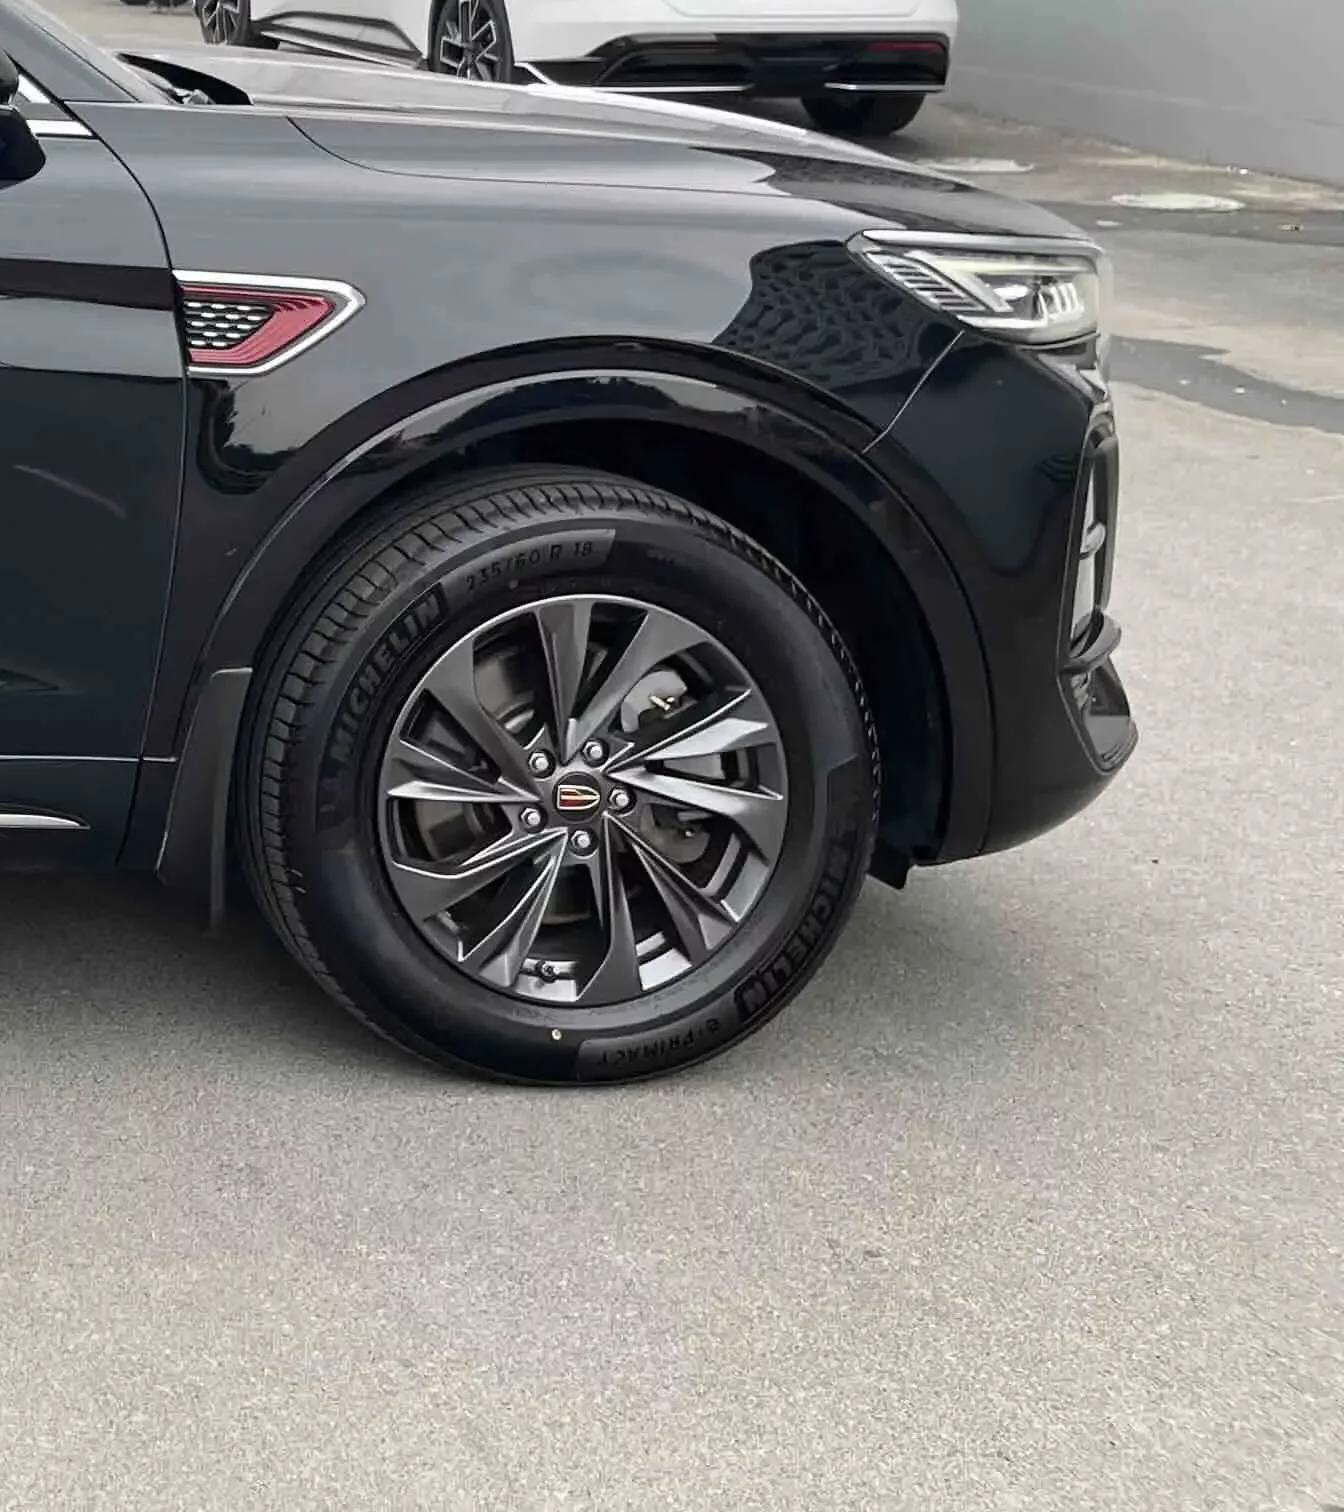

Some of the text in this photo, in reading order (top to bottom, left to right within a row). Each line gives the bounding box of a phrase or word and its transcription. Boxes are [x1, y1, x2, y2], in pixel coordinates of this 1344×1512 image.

[466, 548, 541, 591] 235/60
[548, 544, 563, 562] R
[572, 541, 594, 558] 18
[329, 593, 442, 764] MICHELIN
[740, 843, 851, 1014] MICHELIN
